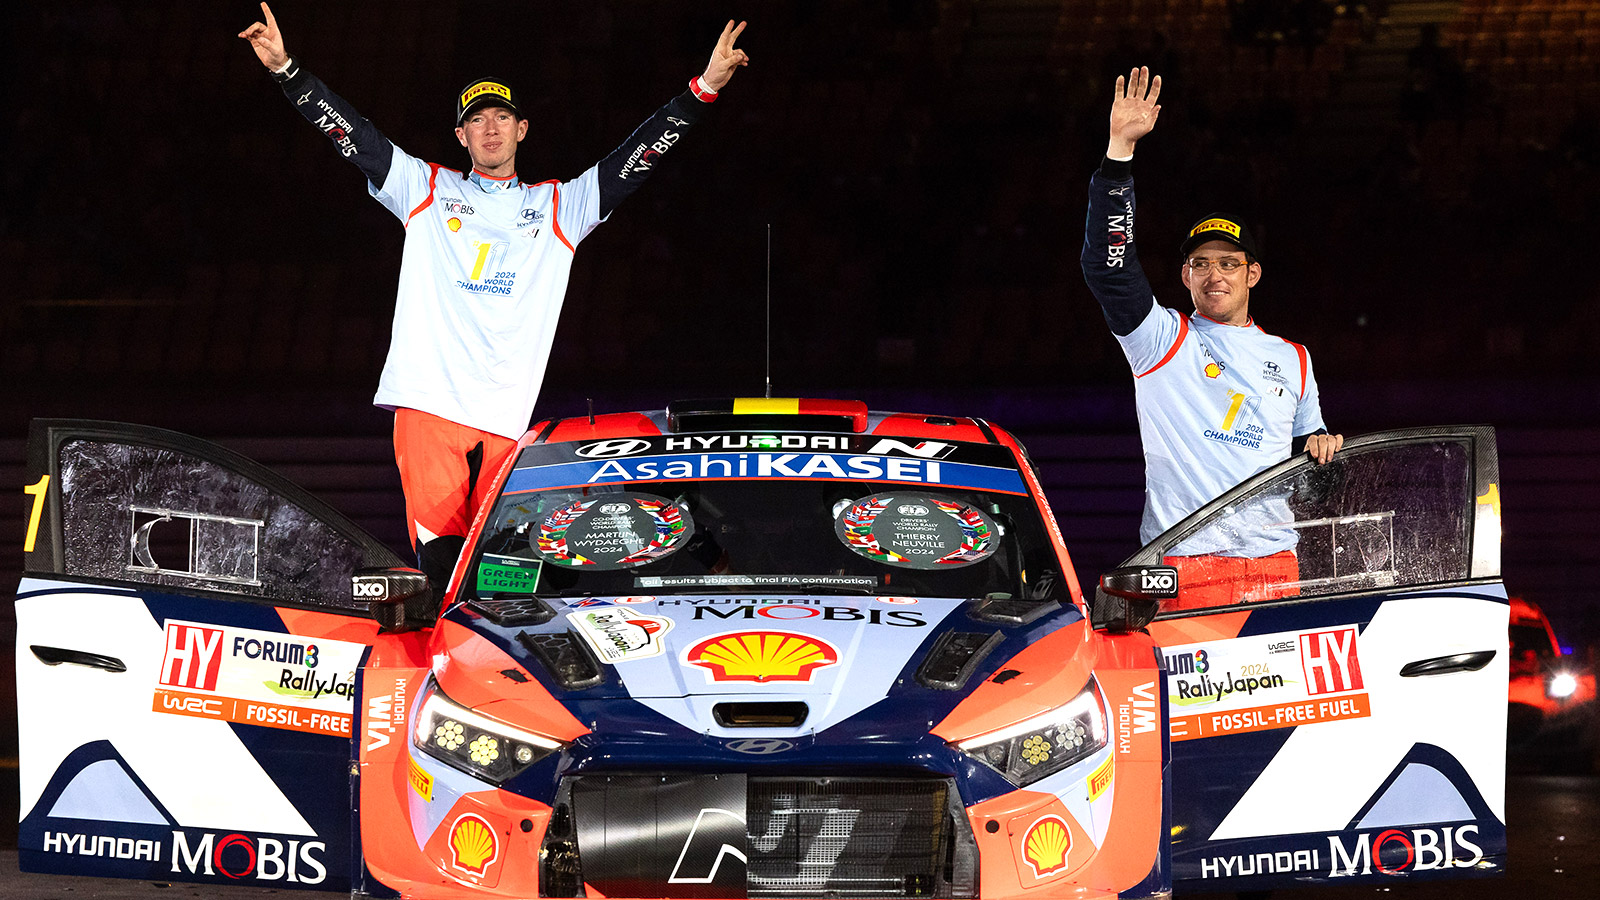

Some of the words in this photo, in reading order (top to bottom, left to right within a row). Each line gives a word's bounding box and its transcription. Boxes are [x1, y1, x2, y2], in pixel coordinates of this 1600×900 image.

[317, 99, 354, 134] HYUNDAI
[314, 114, 358, 158] MOBIS
[618, 142, 648, 180] HYUNDAI
[633, 129, 680, 173] MOBIS
[444, 202, 475, 216] MOBIS
[1106, 215, 1127, 268] MOBIS
[455, 280, 512, 295] CHAMPIONS
[484, 278, 514, 287] WORLD
[494, 271, 516, 279] 2024
[1203, 429, 1260, 449] CHAMPIONS
[1234, 429, 1263, 442] WORLD
[1245, 423, 1264, 435] 2024
[665, 435, 849, 451] HYUNDAI
[23, 474, 51, 553] 1
[574, 537, 646, 547] WYDAEGHE
[892, 540, 945, 549] NEUVILLE
[894, 532, 941, 541] THIERRY
[483, 568, 534, 580] GREEN
[484, 578, 530, 589] LIGHT
[698, 577, 739, 585] subject
[801, 577, 872, 585] confirmation
[658, 598, 820, 606] HYUNDAI
[691, 604, 928, 628] MOBIS
[161, 624, 223, 689] HY
[232, 637, 319, 669] FORUM8
[1300, 630, 1363, 694] HY
[1240, 663, 1270, 677] 2024
[279, 668, 355, 701] RallyJap
[163, 694, 223, 715] WRC
[393, 678, 406, 724] HYUNDAI
[246, 705, 350, 733] FOSSIL-FREE
[1212, 704, 1316, 732] FOSSIL-FREE
[1319, 699, 1360, 717] FUEL
[1119, 704, 1130, 754] HYUNDAI
[43, 831, 161, 862] HYUNDAI
[171, 830, 327, 885] MOBIS
[1327, 824, 1484, 878] MOBIS
[1201, 849, 1320, 879] HYUNDAI
